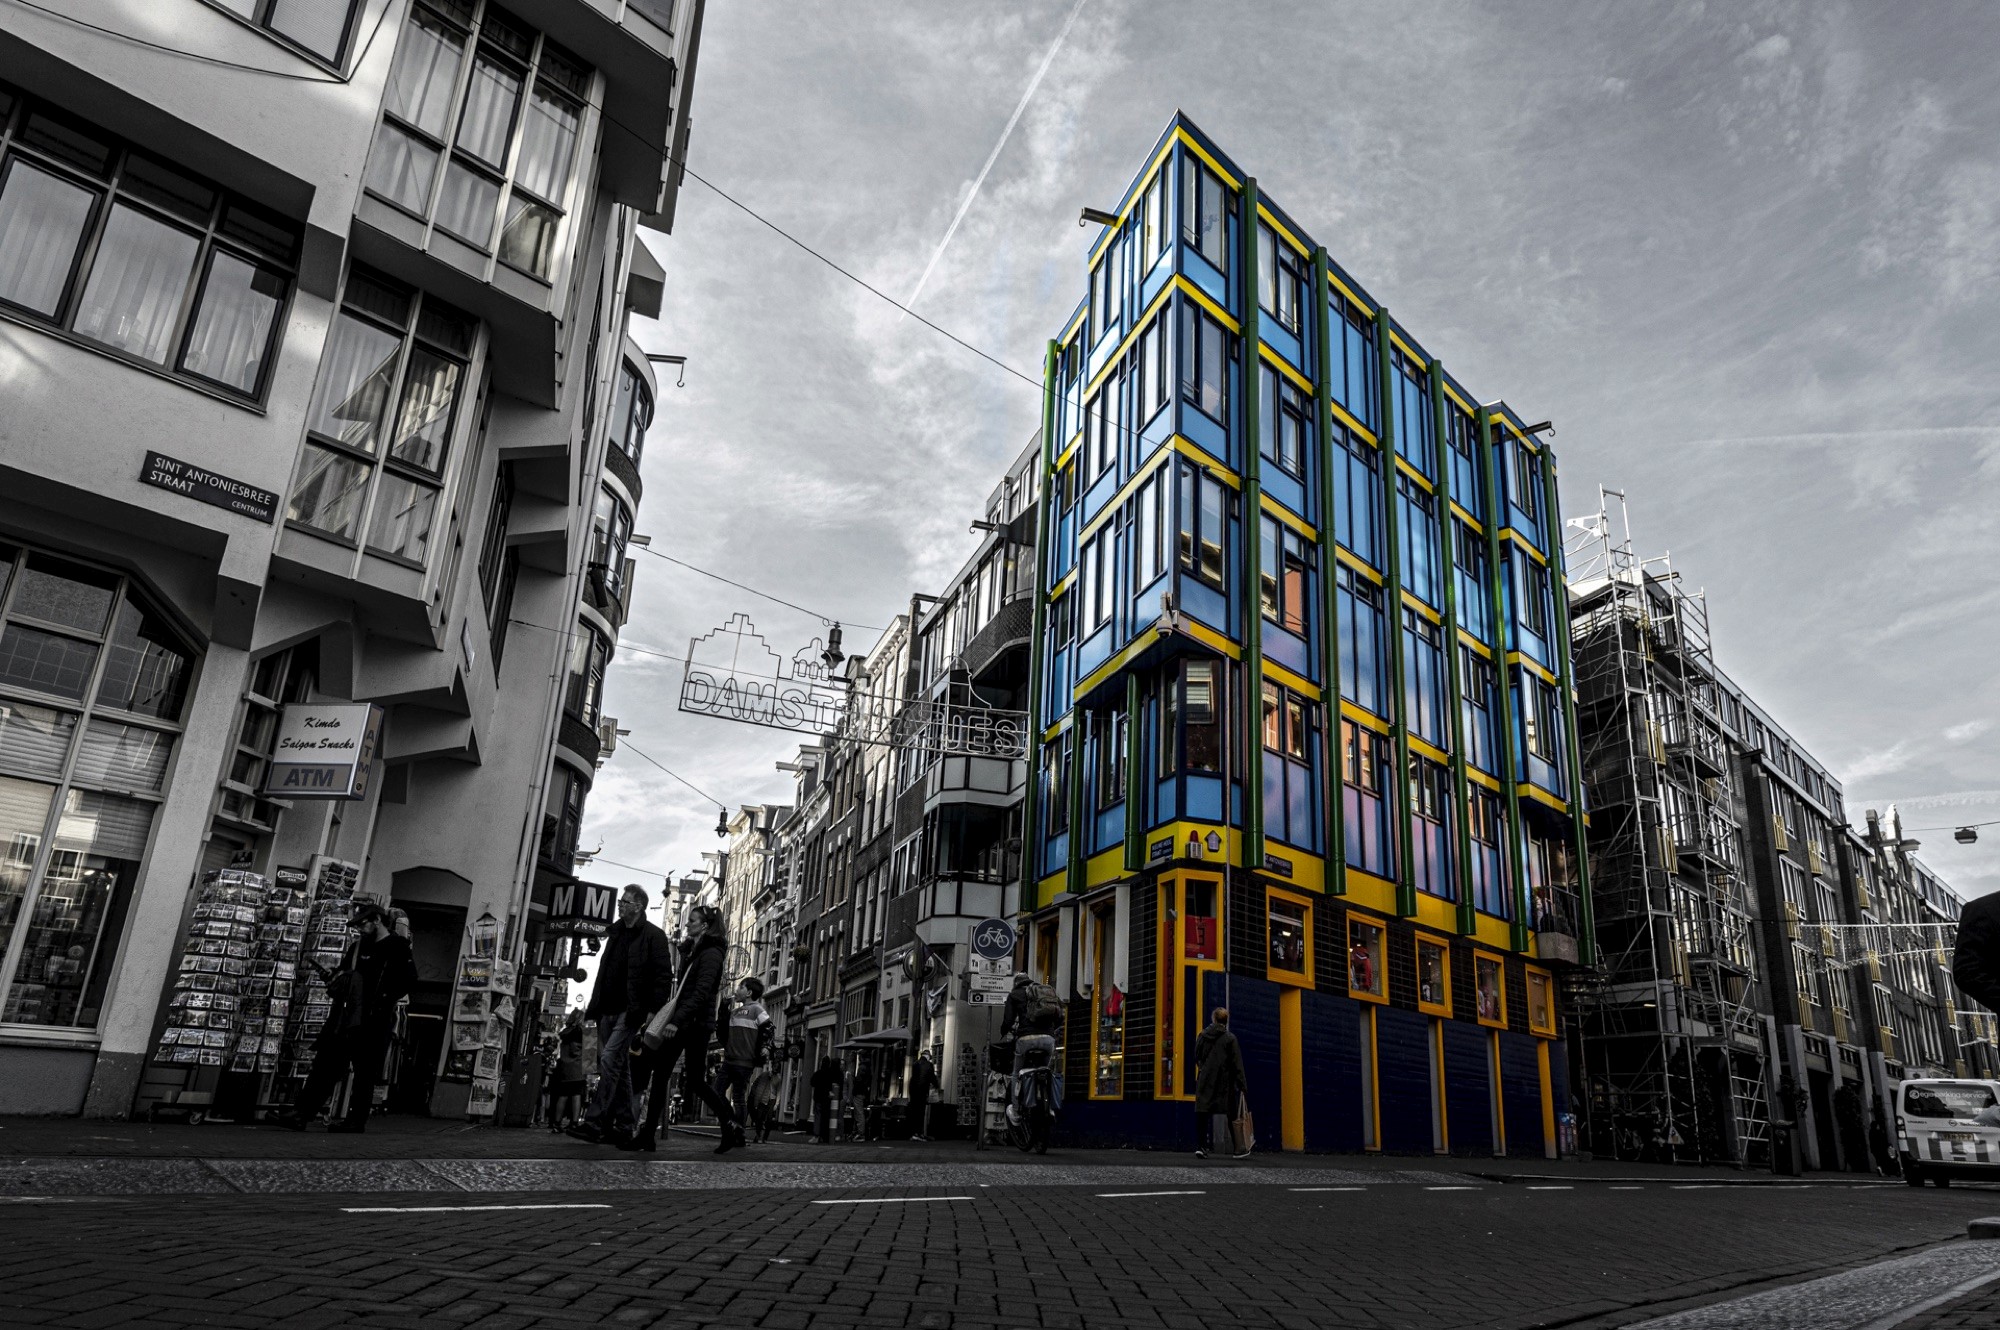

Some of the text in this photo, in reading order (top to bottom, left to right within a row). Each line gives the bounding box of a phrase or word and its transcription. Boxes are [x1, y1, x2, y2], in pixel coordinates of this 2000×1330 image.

[150, 471, 195, 493] STRAAT
[154, 457, 272, 505] SINT ANTONIESBREE
[231, 500, 268, 517] CENTRUM
[303, 716, 341, 728] Kimdo
[280, 737, 355, 751] Saigon Snacks
[357, 729, 375, 775] ATM
[283, 768, 335, 787] ATM
[552, 885, 575, 917] M
[583, 886, 610, 920] M
[550, 921, 570, 930] R-NET
[1935, 1091, 1961, 1099] parking
